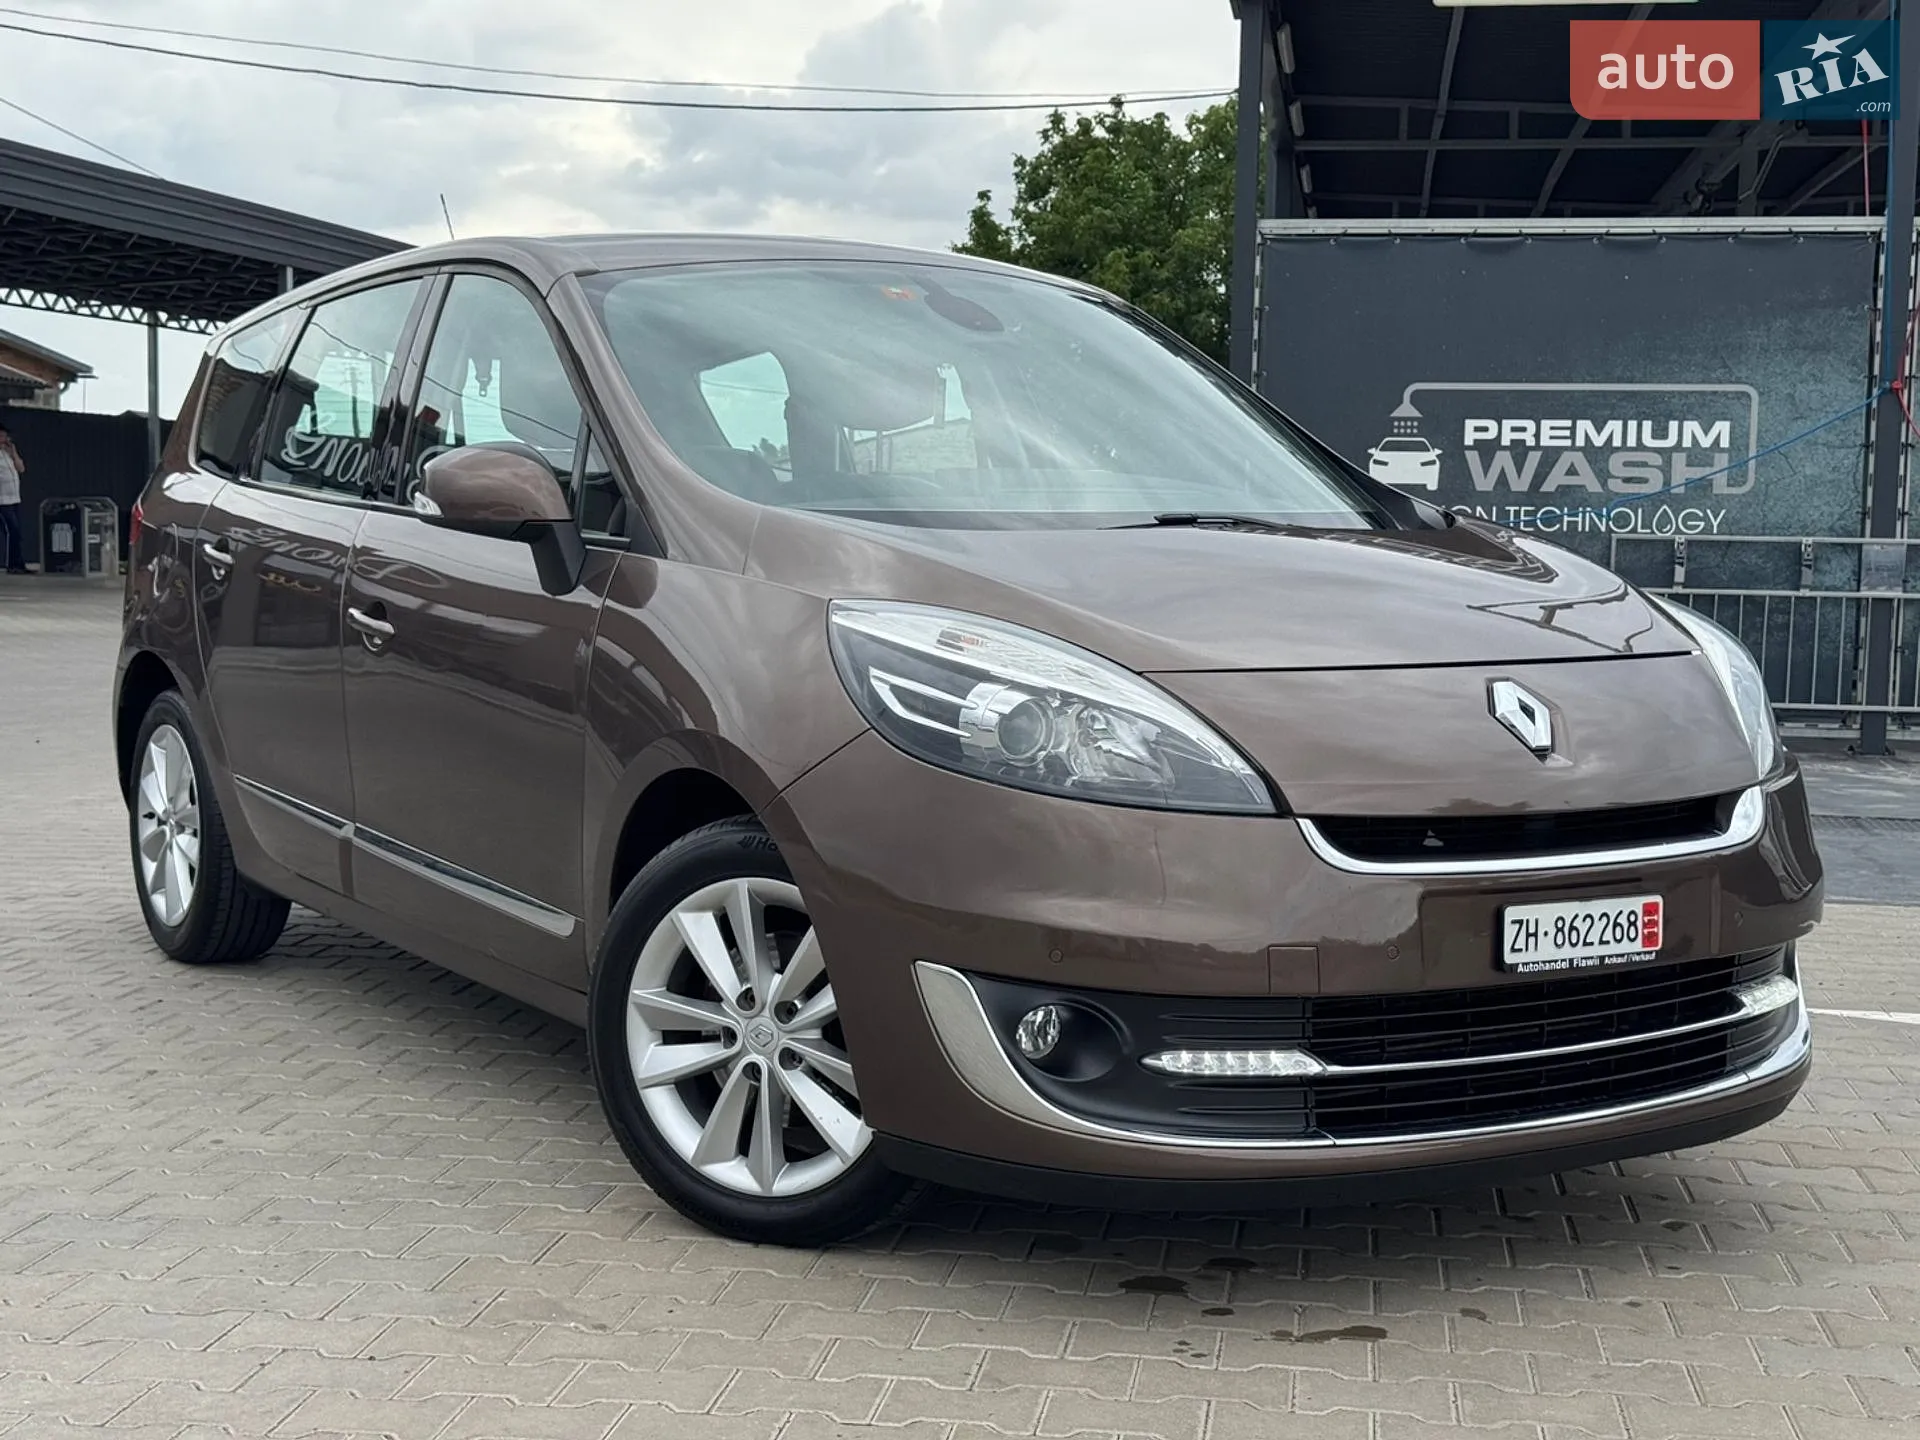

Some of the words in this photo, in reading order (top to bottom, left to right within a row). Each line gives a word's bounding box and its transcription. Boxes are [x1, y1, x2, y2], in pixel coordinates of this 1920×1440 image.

[1463, 418, 1731, 448] PREMIUM
[1464, 450, 1730, 495] WASH
[1517, 958, 1570, 974] Autohandel
